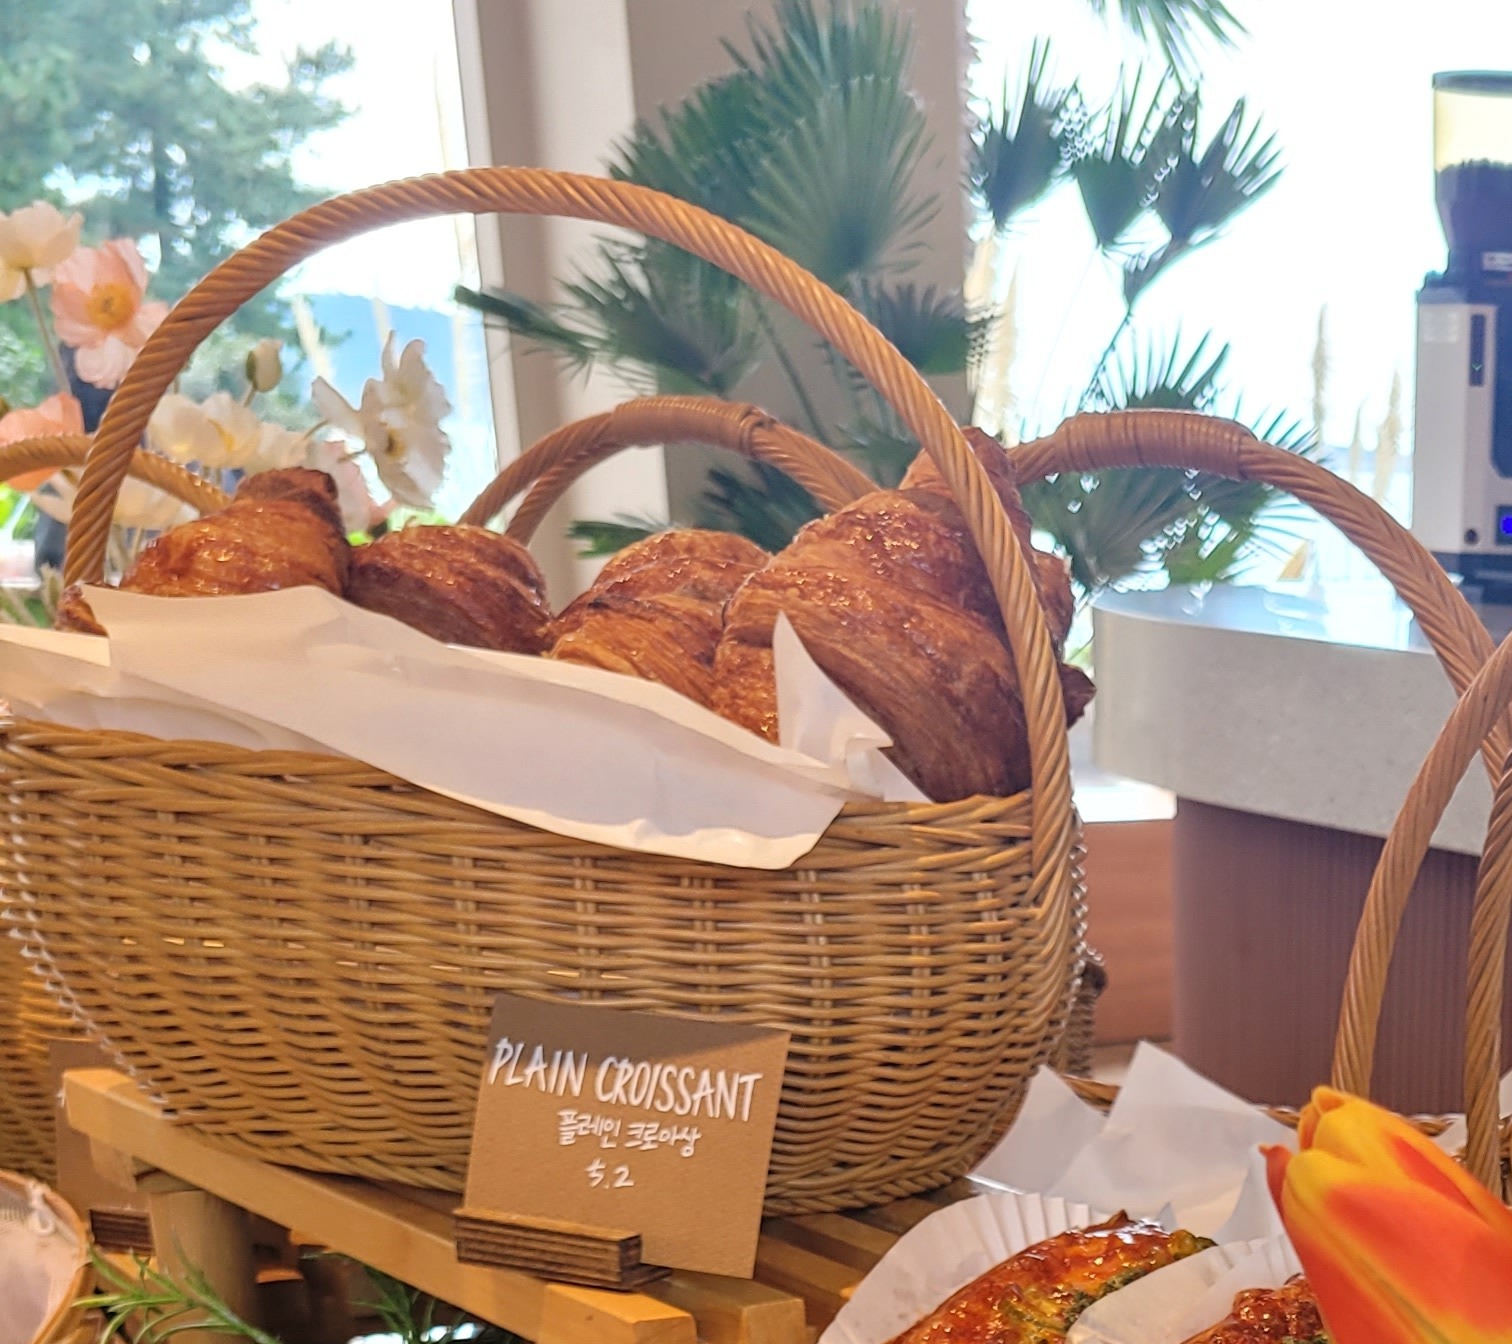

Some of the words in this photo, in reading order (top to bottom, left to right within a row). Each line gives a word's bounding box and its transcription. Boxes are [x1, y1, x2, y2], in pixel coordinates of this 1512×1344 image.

[488, 1038, 588, 1097] PLAIN
[595, 1056, 763, 1121] CROISSANT
[558, 1108, 621, 1149] 플레인
[624, 1122, 701, 1158] 크로아상
[585, 1158, 635, 1189] 5.2
